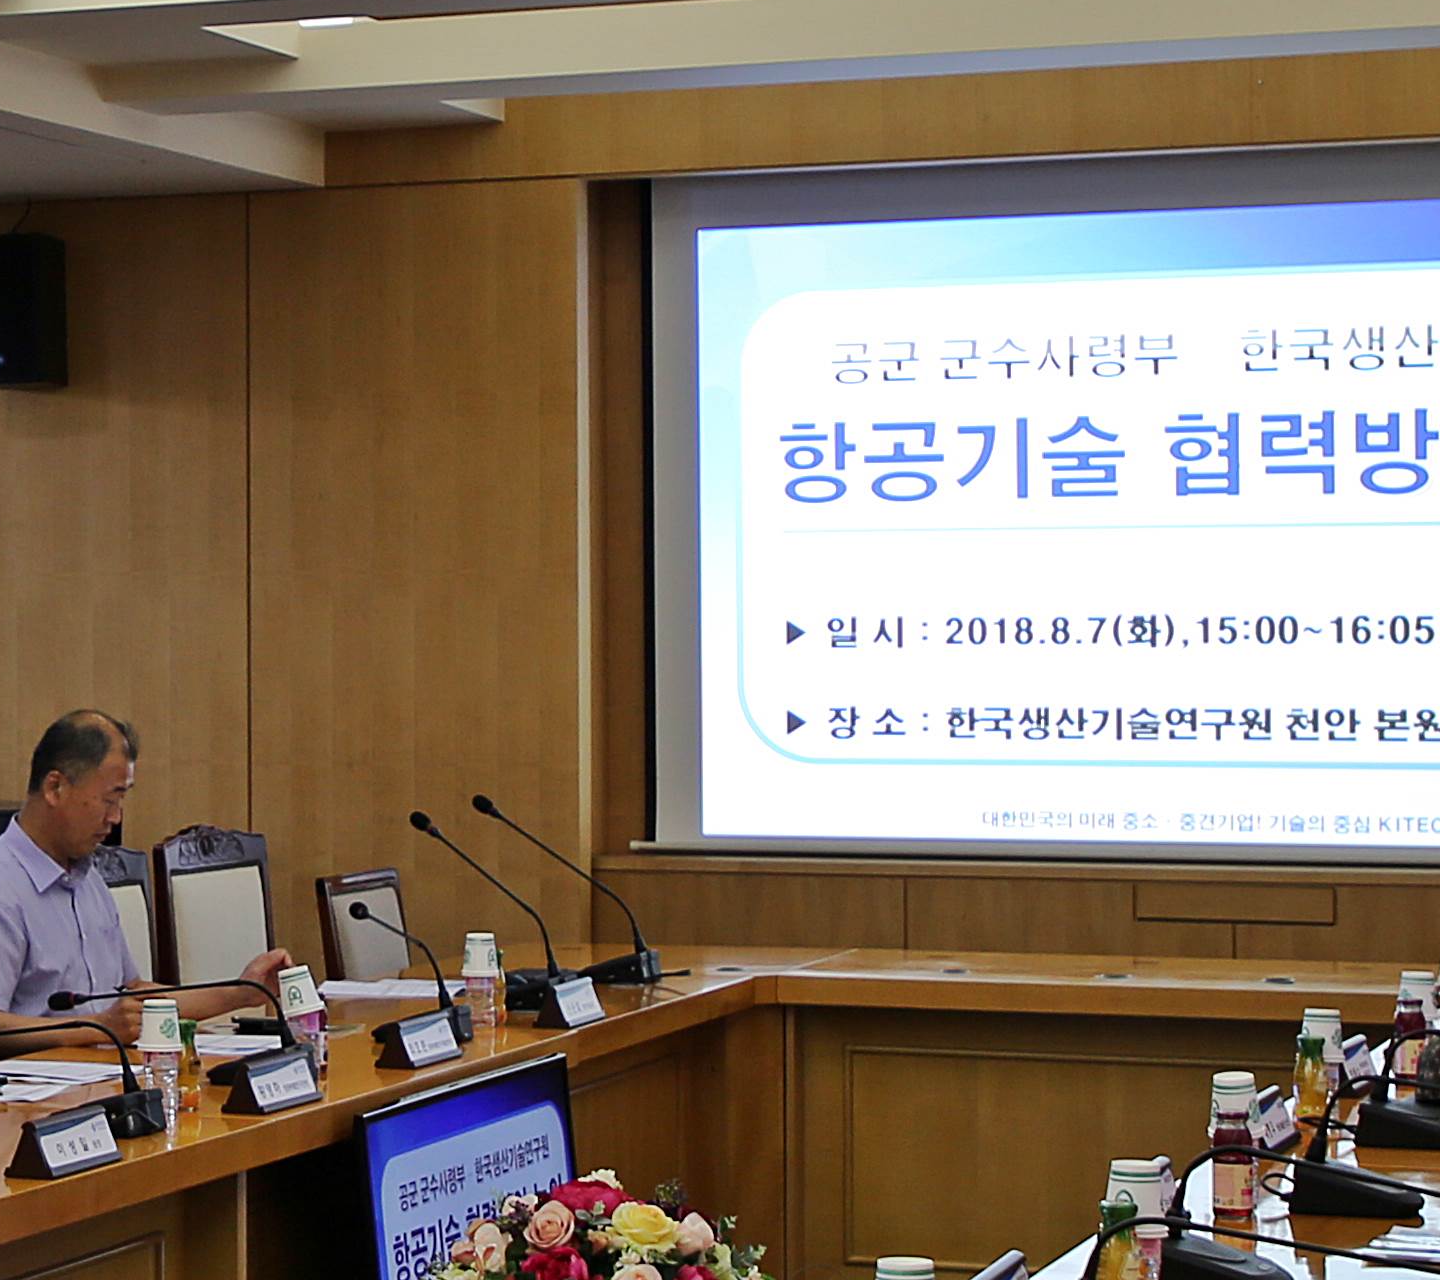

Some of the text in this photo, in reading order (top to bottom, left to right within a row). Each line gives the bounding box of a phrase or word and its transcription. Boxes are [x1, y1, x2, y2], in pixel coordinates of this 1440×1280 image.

[832, 342, 919, 384] 공군
[941, 335, 1178, 379] 군수사령부
[780, 416, 1125, 503] 항공기술
[947, 707, 1271, 741] 한국생산기술연구원
[1287, 709, 1360, 741] 천안
[983, 811, 1073, 828] 대한민국의
[1080, 812, 1115, 829] 미래
[1123, 813, 1158, 830] 중소
[1270, 815, 1325, 833] 기술의
[1334, 816, 1371, 834] 중심
[399, 1181, 418, 1211] 공군
[421, 1164, 466, 1203] 군수사령부
[475, 1135, 549, 1183] 한국생산기술연구원
